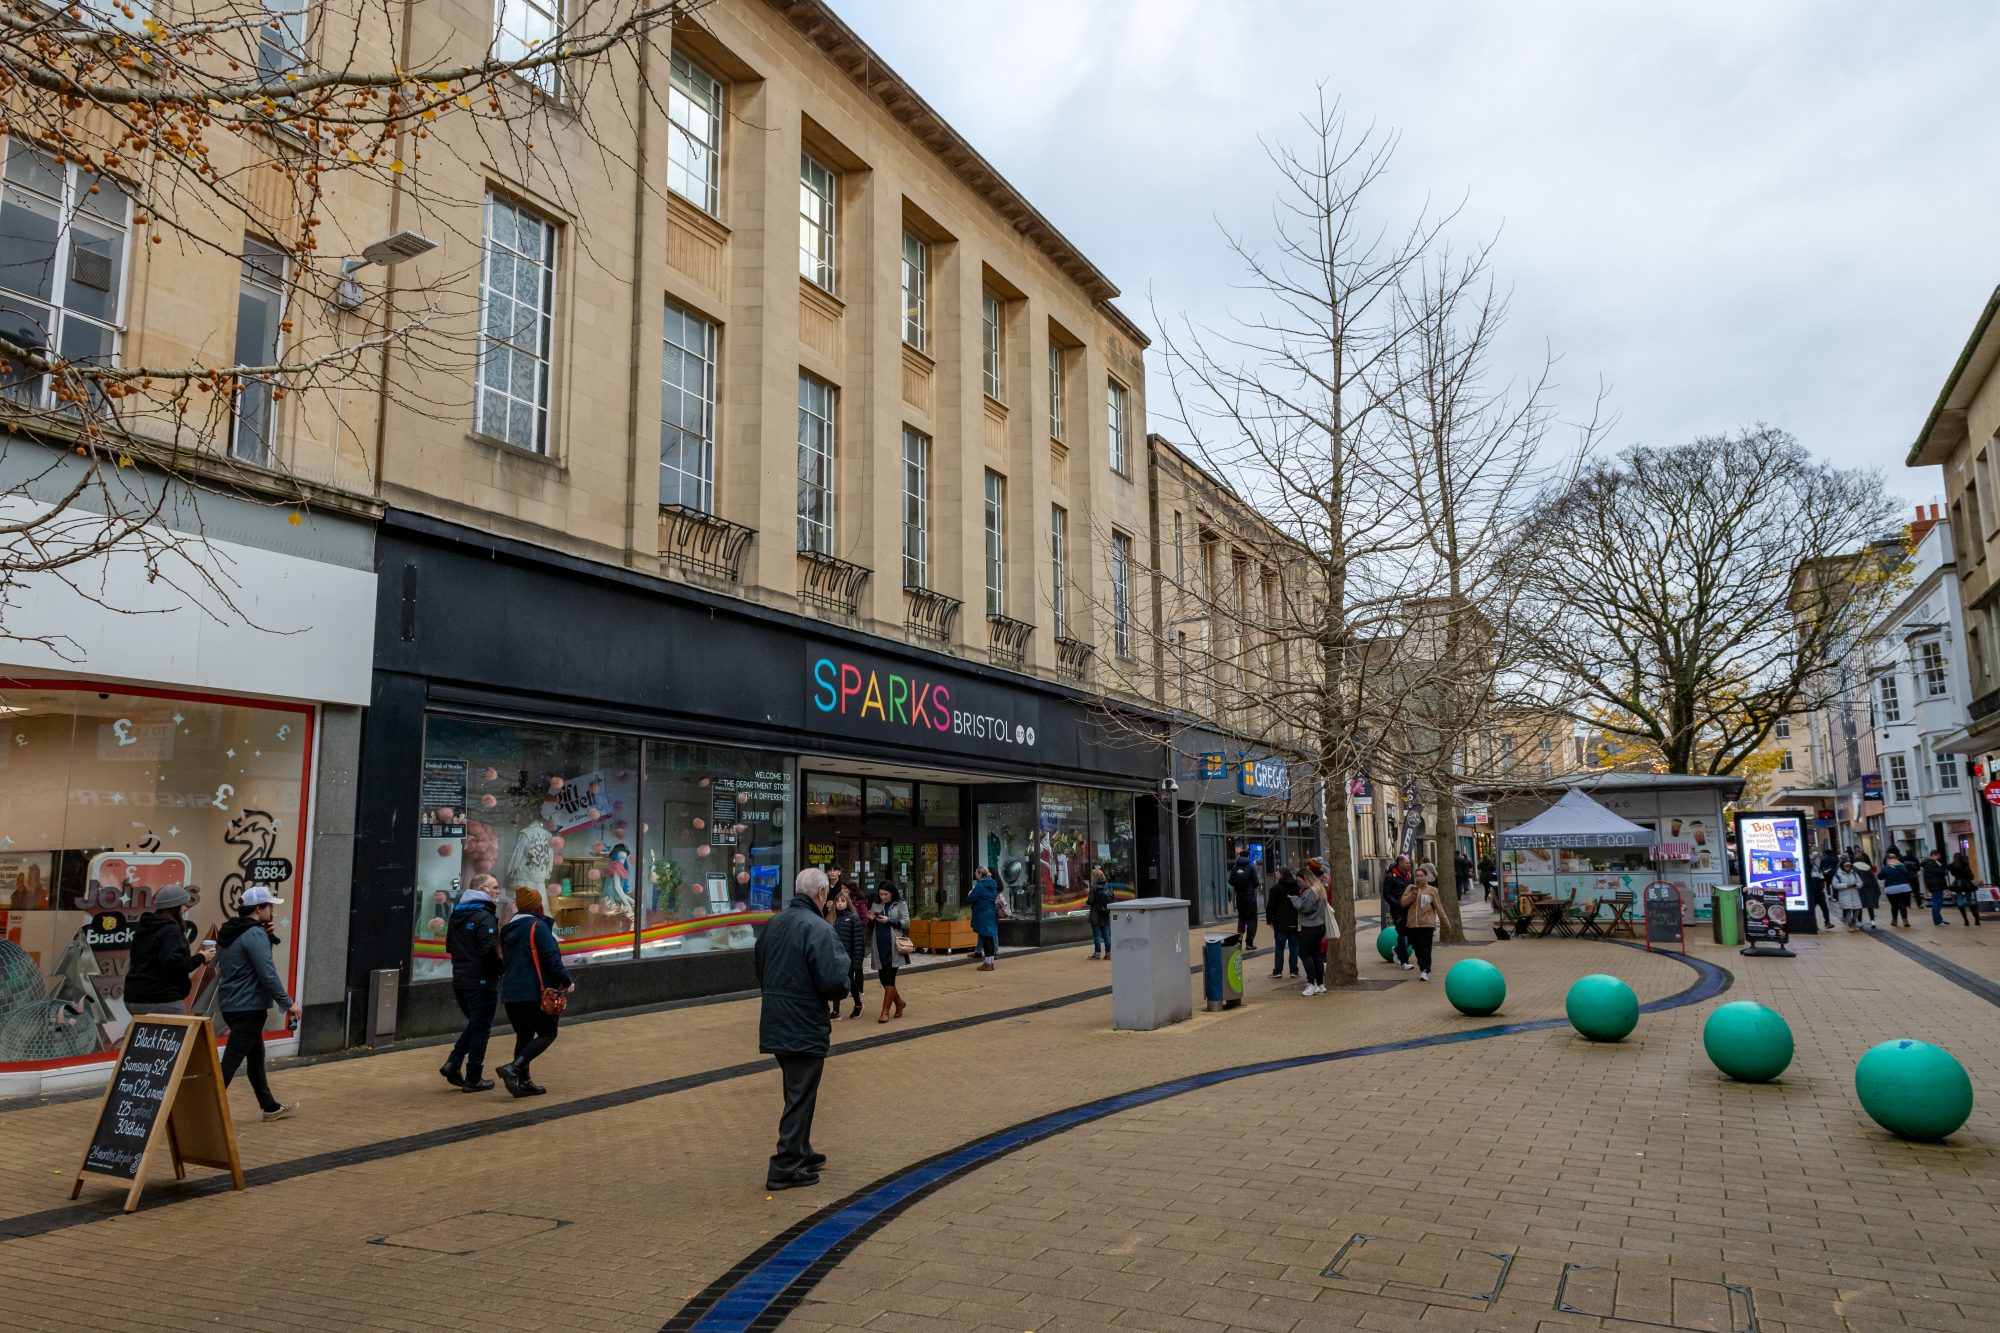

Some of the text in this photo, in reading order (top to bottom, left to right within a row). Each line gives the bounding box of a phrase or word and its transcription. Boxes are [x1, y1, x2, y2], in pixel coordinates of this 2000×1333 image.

[814, 658, 1013, 743] SPARKS BRISTOL
[755, 771, 782, 780] WELCOME
[723, 780, 735, 788] THE
[736, 781, 772, 790] DEPARTMENT
[773, 783, 791, 791] STORE
[738, 792, 753, 800] WITH
[759, 793, 791, 802] DIFFERENCE
[1751, 822, 1773, 832] Big
[809, 843, 834, 854] FASHION
[1504, 835, 1635, 849] ASIAN STREET FOOD
[894, 845, 913, 854] NATURE
[254, 866, 287, 879] £684
[75, 879, 152, 910] Join
[86, 927, 136, 945] Black
[134, 1027, 181, 1062] Black Friday
[122, 1056, 168, 1078] Samsung S24
[132, 1079, 151, 1098] £22
[117, 1100, 133, 1117] £25
